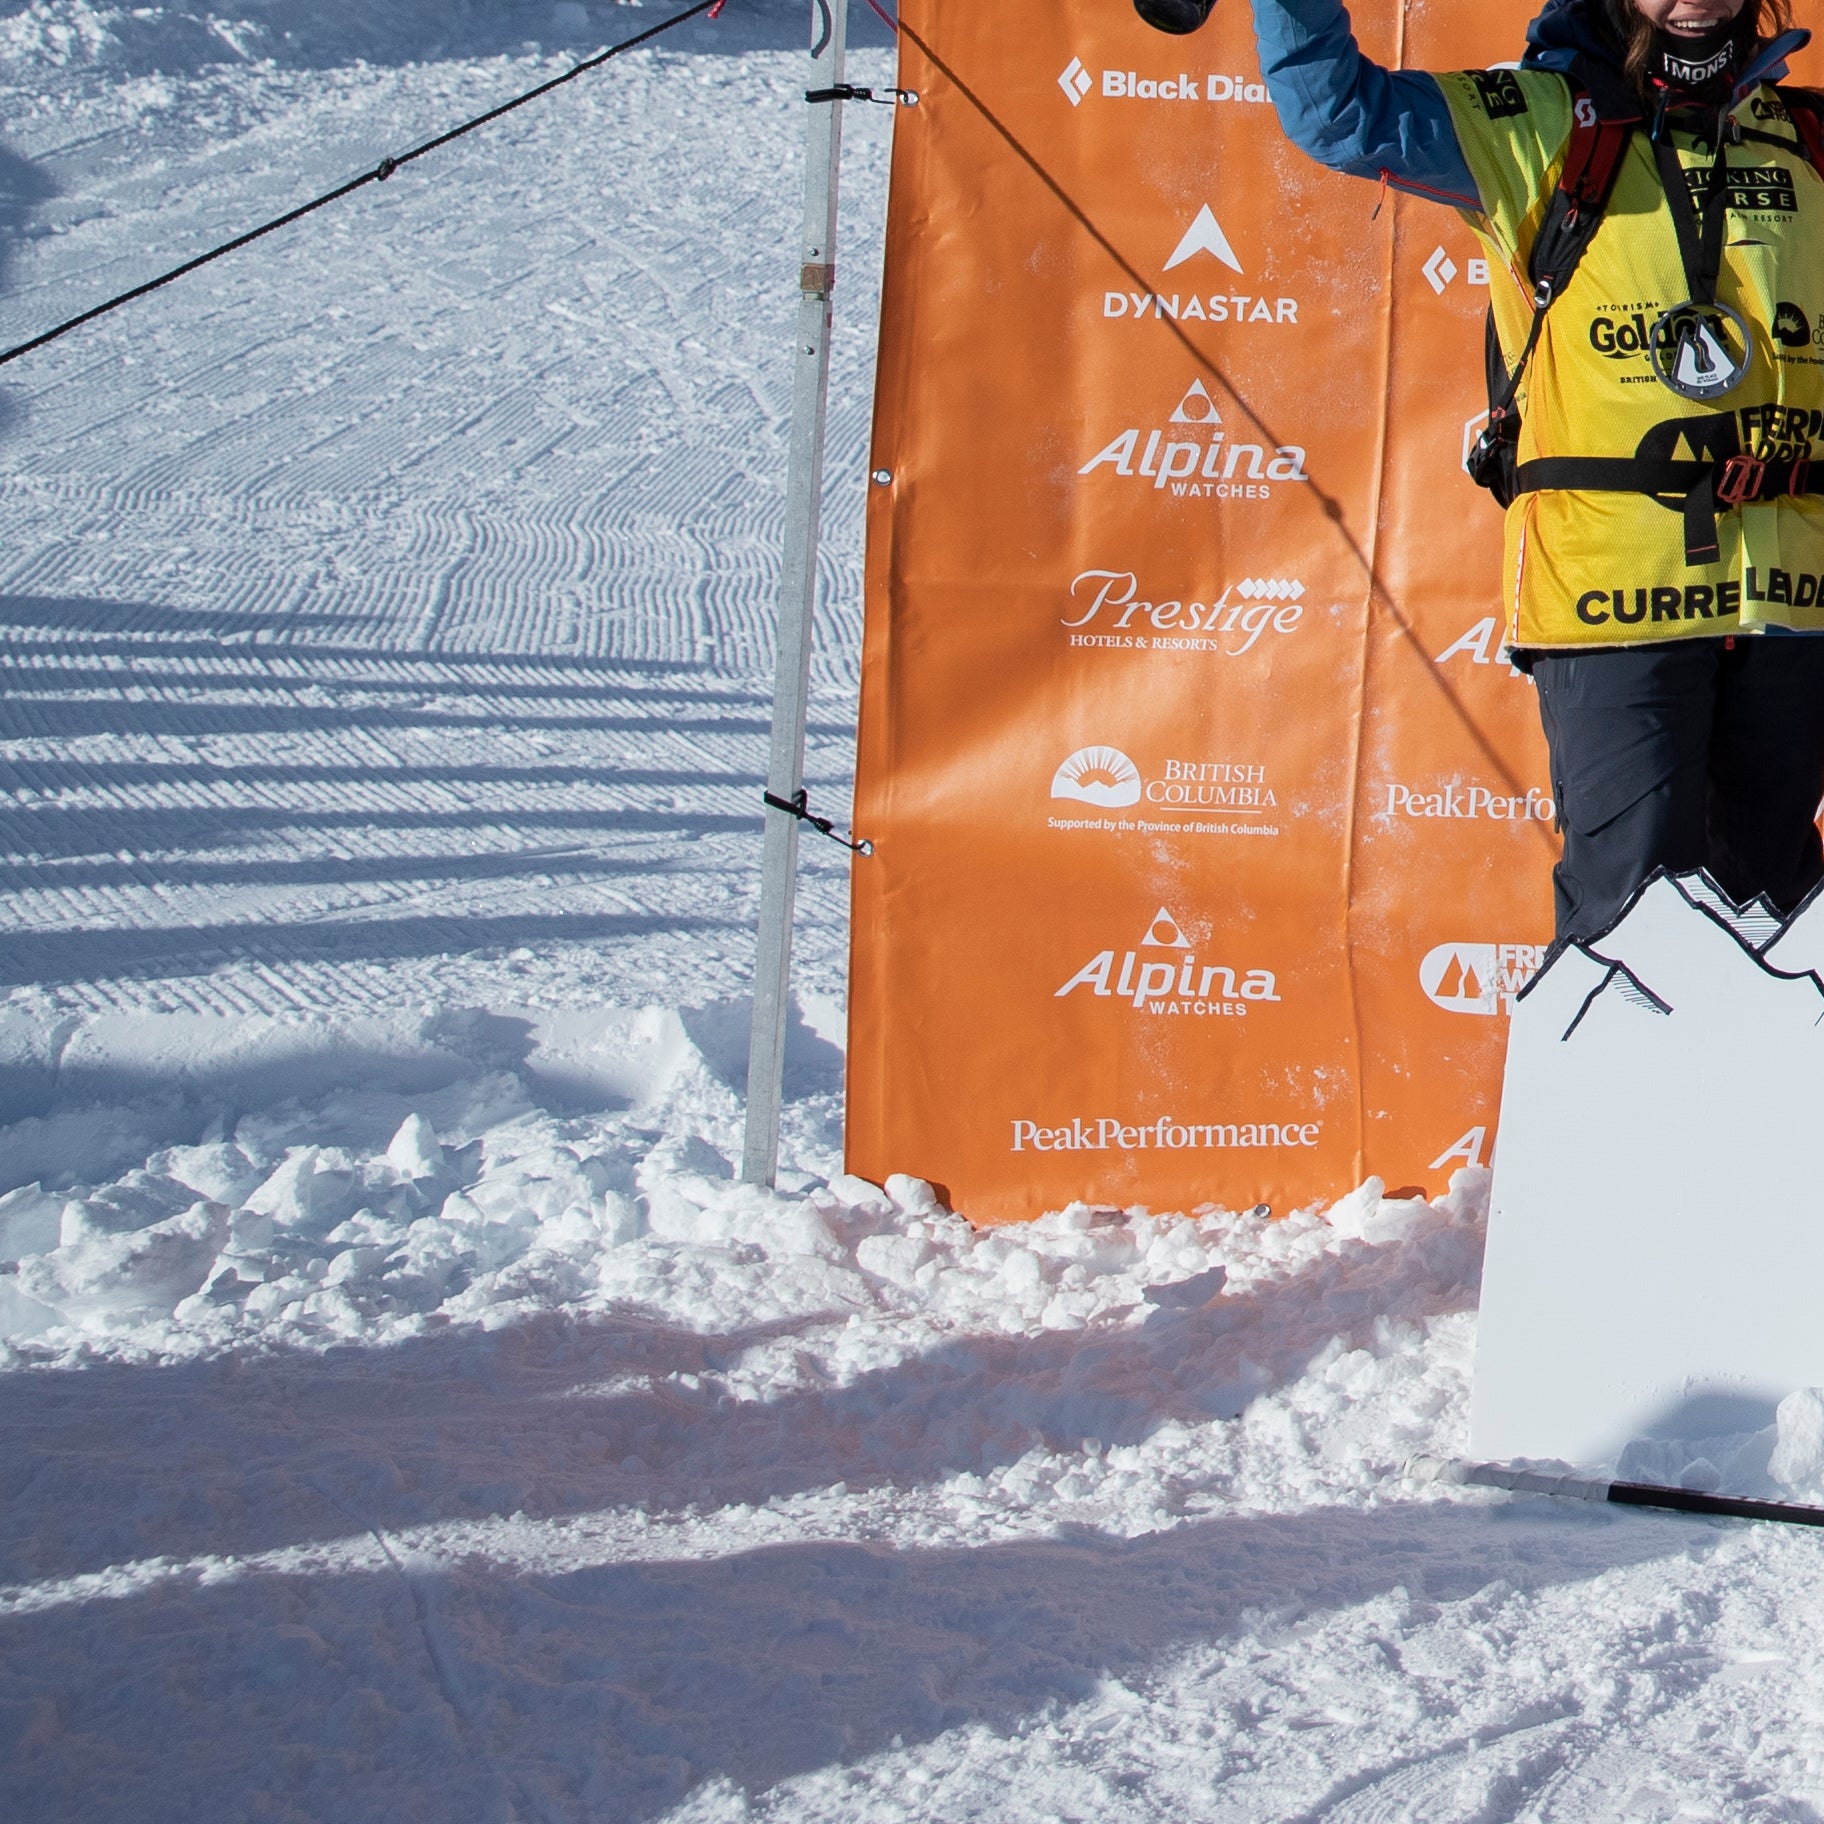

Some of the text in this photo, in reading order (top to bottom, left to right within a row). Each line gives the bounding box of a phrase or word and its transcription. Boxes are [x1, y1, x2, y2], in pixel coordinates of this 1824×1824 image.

[1671, 51, 1727, 81] MONS
[1103, 71, 1198, 101] Black
[1104, 292, 1298, 324] DYNASTAR
[1077, 428, 1309, 488] Alpina
[1171, 482, 1270, 500] WATCHES
[1060, 569, 1305, 657] Prestige
[1577, 581, 1740, 626] CURRE
[1070, 633, 1218, 652] HOTELS RESORTS
[1164, 758, 1266, 785] BRITISH
[1146, 779, 1278, 808] COLUMBIA
[1048, 816, 1279, 836] Supported by the Province of British Columbia
[1054, 949, 1281, 1008] Alpina
[1149, 1000, 1247, 1017] WATCHES
